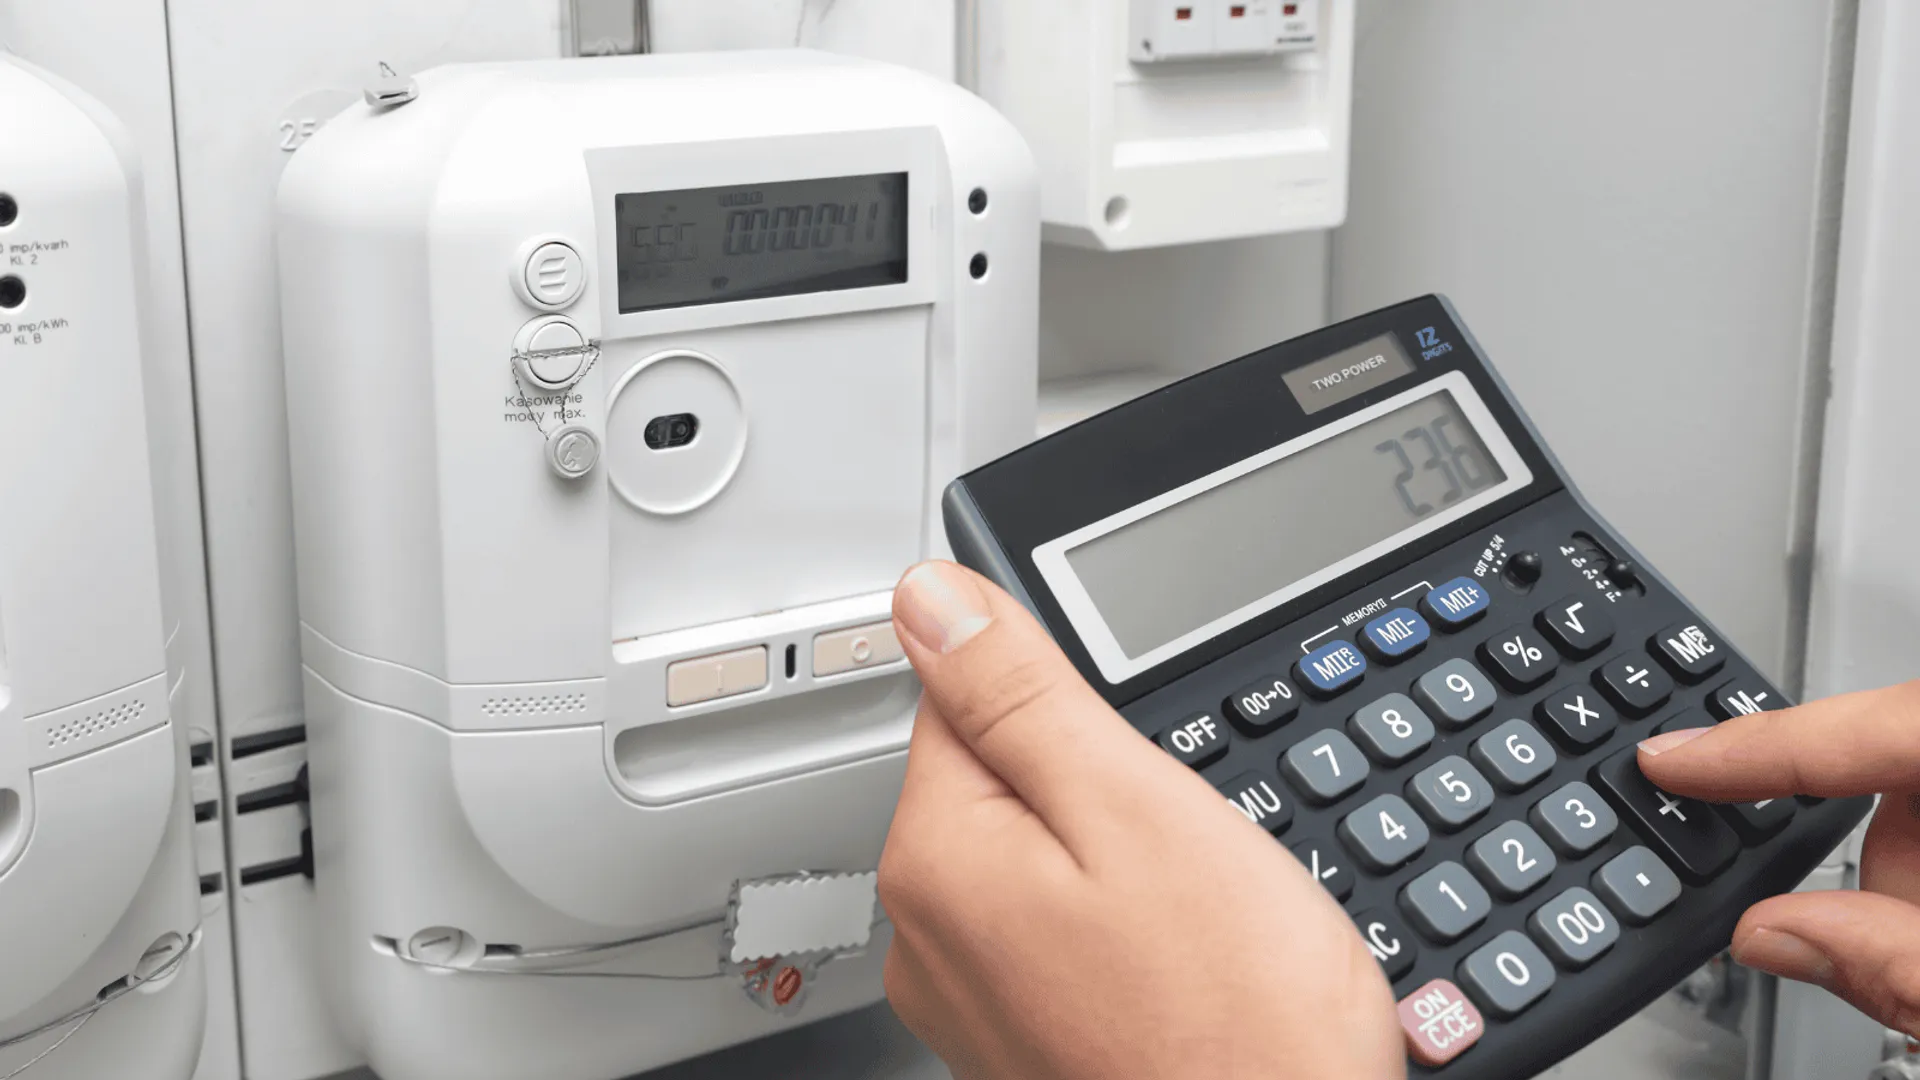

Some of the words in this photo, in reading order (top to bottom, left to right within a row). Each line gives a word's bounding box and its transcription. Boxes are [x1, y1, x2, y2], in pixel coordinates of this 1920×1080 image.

[30, 254, 39, 265] 2
[1414, 326, 1440, 348] 12
[1311, 372, 1341, 391] TWO
[1341, 354, 1387, 379] POWER
[504, 391, 583, 407] Kasowanie
[553, 408, 586, 420] max.
[1374, 414, 1493, 516] 236
[1473, 559, 1489, 577] CUT
[1481, 548, 1495, 562] UP
[1489, 534, 1505, 551] 5/4
[1582, 568, 1596, 580] 2
[1595, 579, 1606, 590] 4
[1605, 591, 1617, 603] F
[1445, 673, 1475, 702] 9
[1171, 715, 1217, 753] OFF
[1381, 709, 1413, 738] 8
[1312, 743, 1341, 777] 7
[1505, 734, 1536, 764] 6
[1438, 770, 1472, 802] 5
[1378, 810, 1407, 841] 4
[1564, 798, 1596, 828] 3
[1502, 838, 1537, 872] 2
[1438, 880, 1468, 912] 1
[1556, 901, 1605, 945] 00
[1495, 951, 1530, 986] 0
[1413, 987, 1449, 1019] ON
